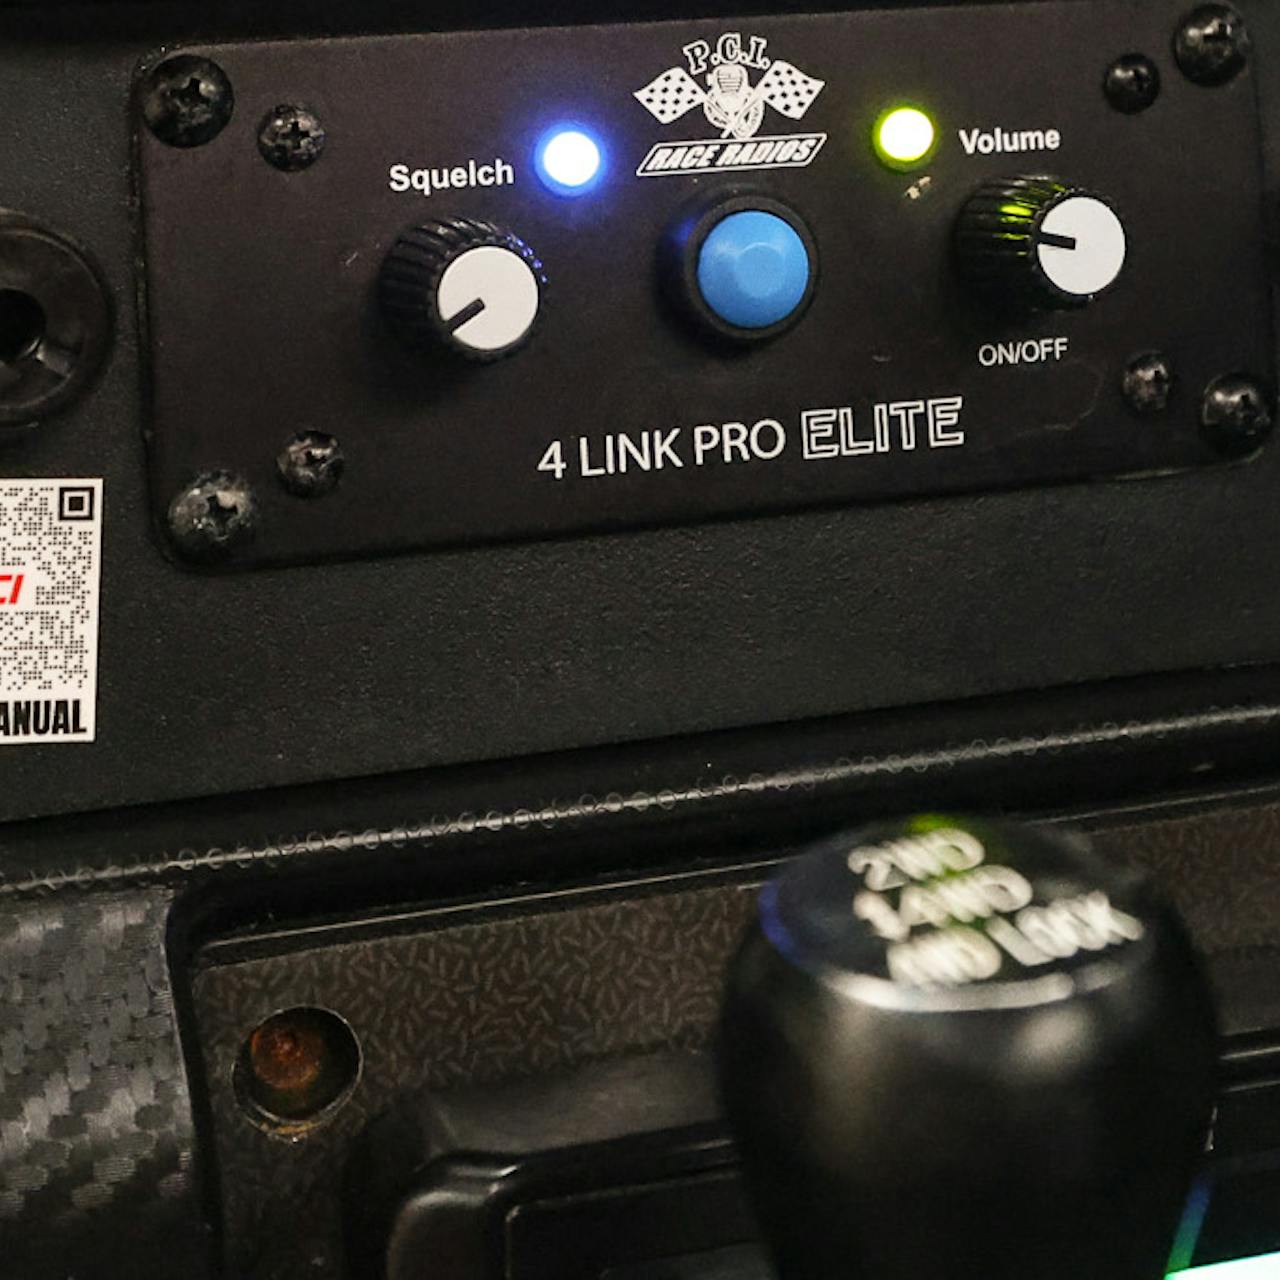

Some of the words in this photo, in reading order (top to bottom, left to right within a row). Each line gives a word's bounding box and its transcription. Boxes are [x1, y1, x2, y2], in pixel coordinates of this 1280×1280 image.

[646, 145, 719, 171] RACE
[716, 139, 816, 167] RADIOS
[959, 128, 1060, 154] Volume
[390, 159, 513, 195] Squelch
[979, 338, 1067, 366] ON/OFF
[538, 441, 566, 478] 4
[580, 428, 683, 476] LINK
[694, 419, 785, 465] PRO
[801, 397, 964, 459] ELITE
